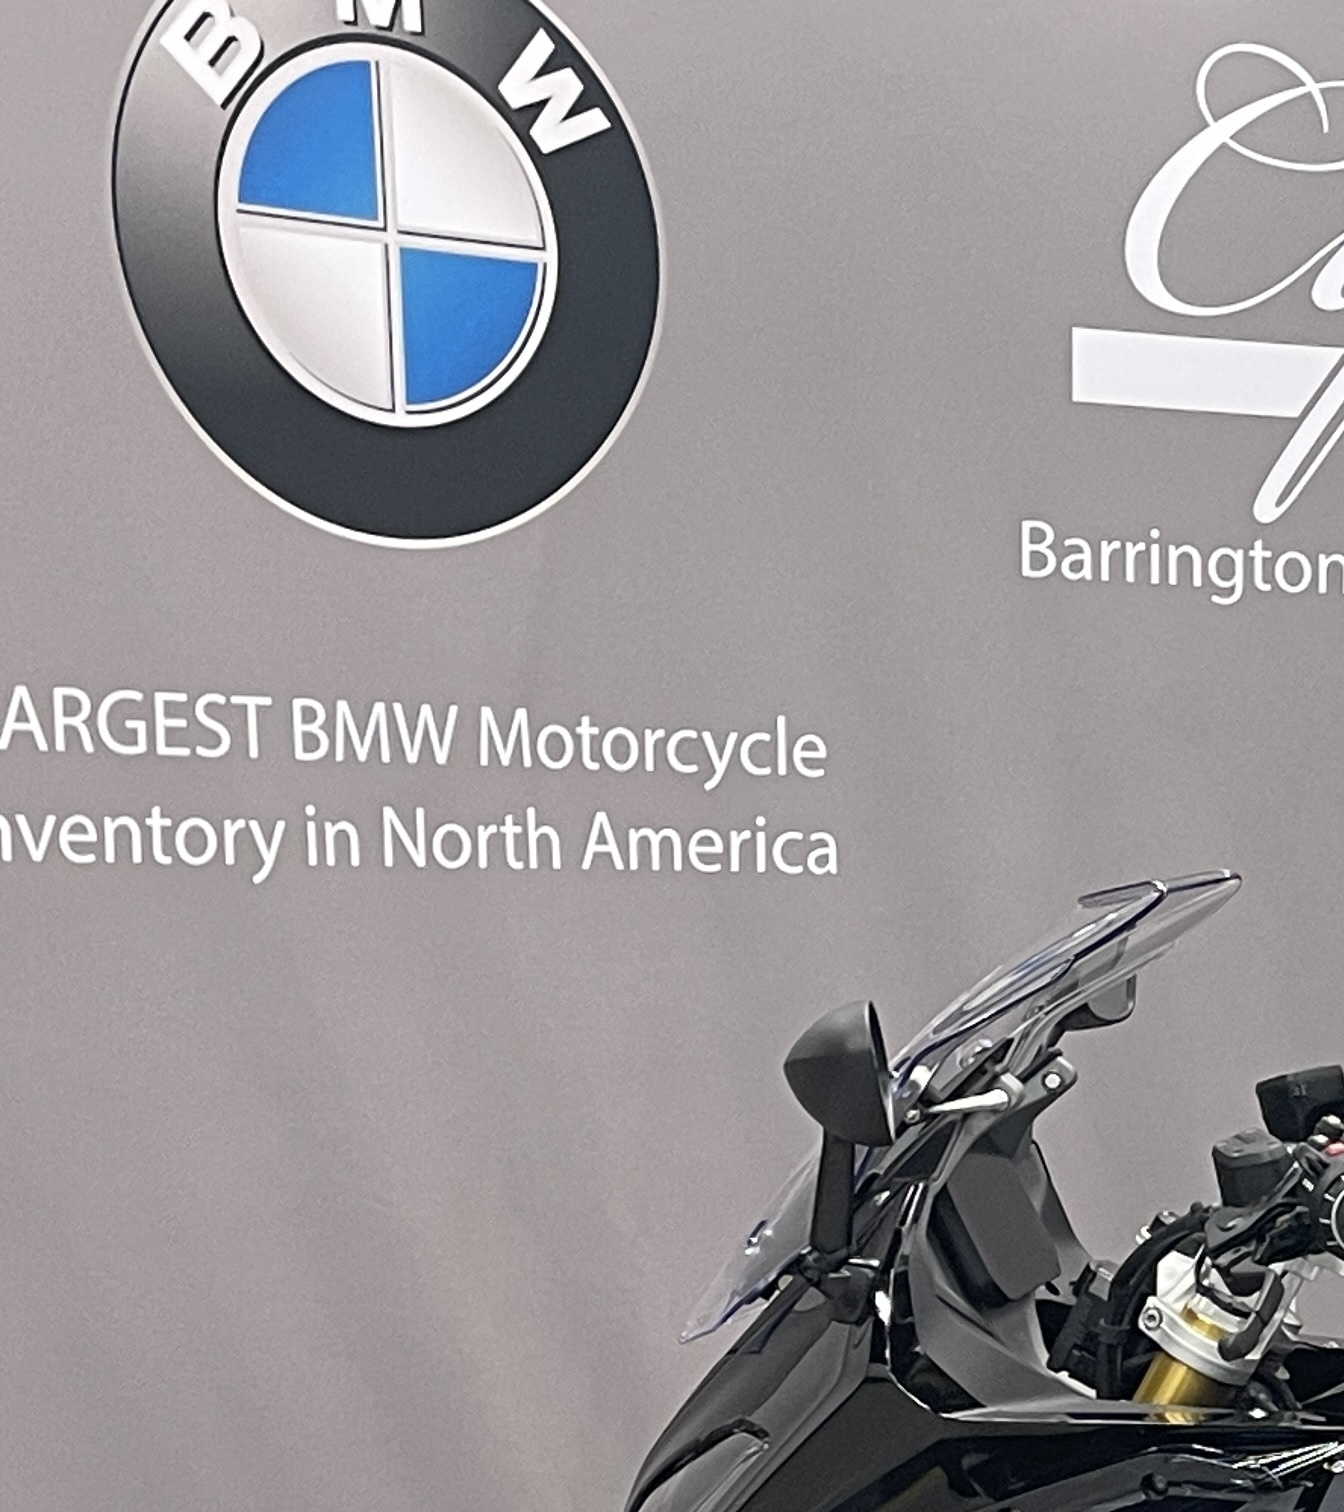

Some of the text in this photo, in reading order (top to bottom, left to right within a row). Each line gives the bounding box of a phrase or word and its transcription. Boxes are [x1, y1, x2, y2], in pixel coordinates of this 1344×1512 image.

[291, 696, 460, 766] BMW
[478, 704, 828, 792] Motorcycle
[304, 803, 361, 868] in
[381, 804, 562, 871] North
[580, 810, 839, 876] America
